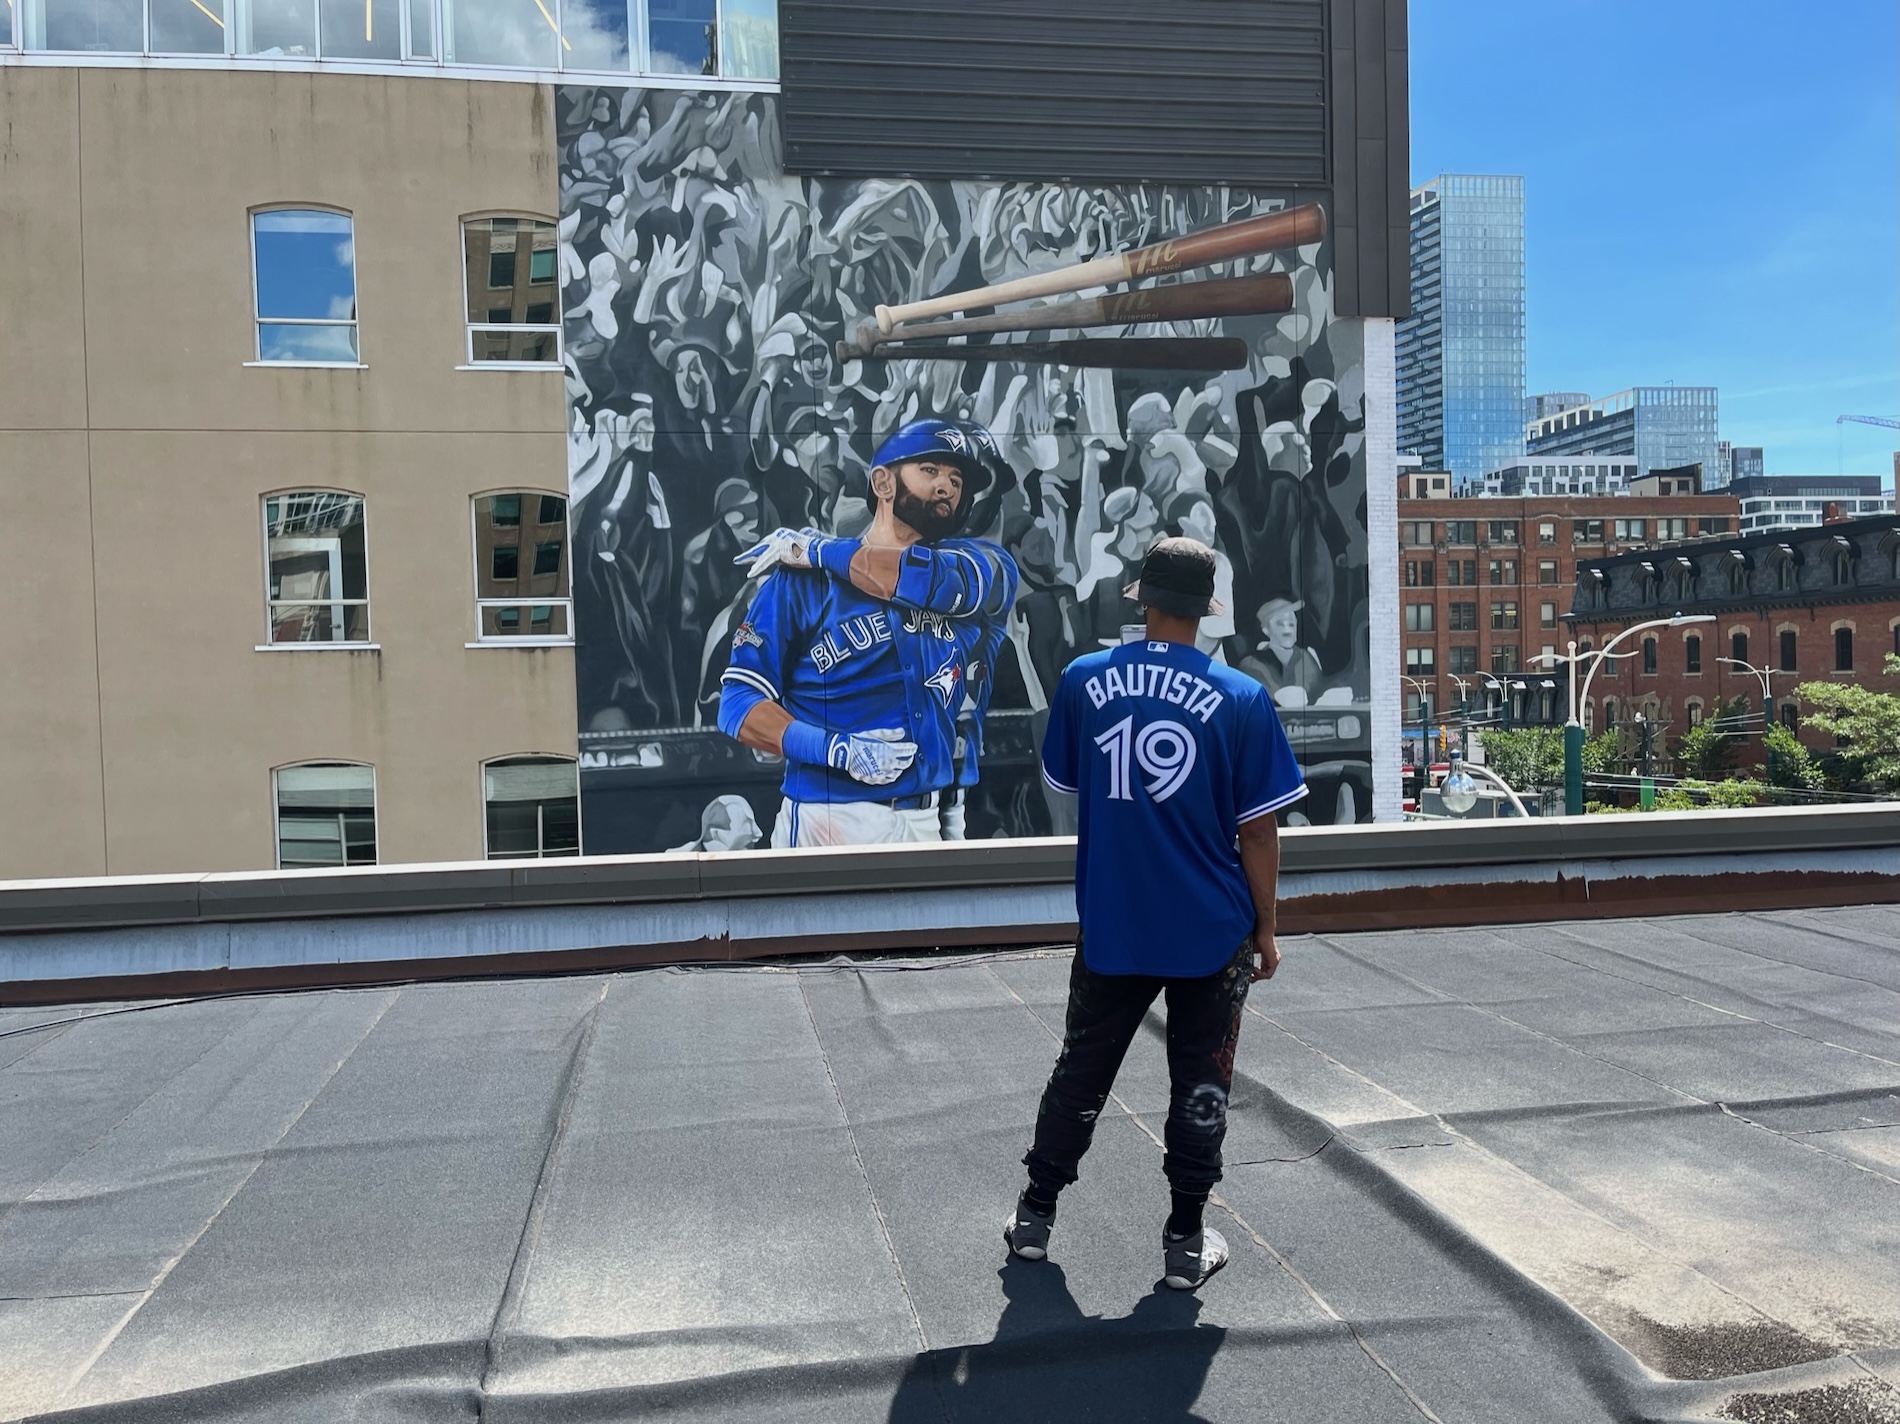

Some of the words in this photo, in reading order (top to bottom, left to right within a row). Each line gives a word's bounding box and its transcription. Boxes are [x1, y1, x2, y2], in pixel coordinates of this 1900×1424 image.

[809, 610, 893, 675] BLUE
[1084, 663, 1224, 724] BAUTISTA
[1093, 714, 1197, 804] 19
